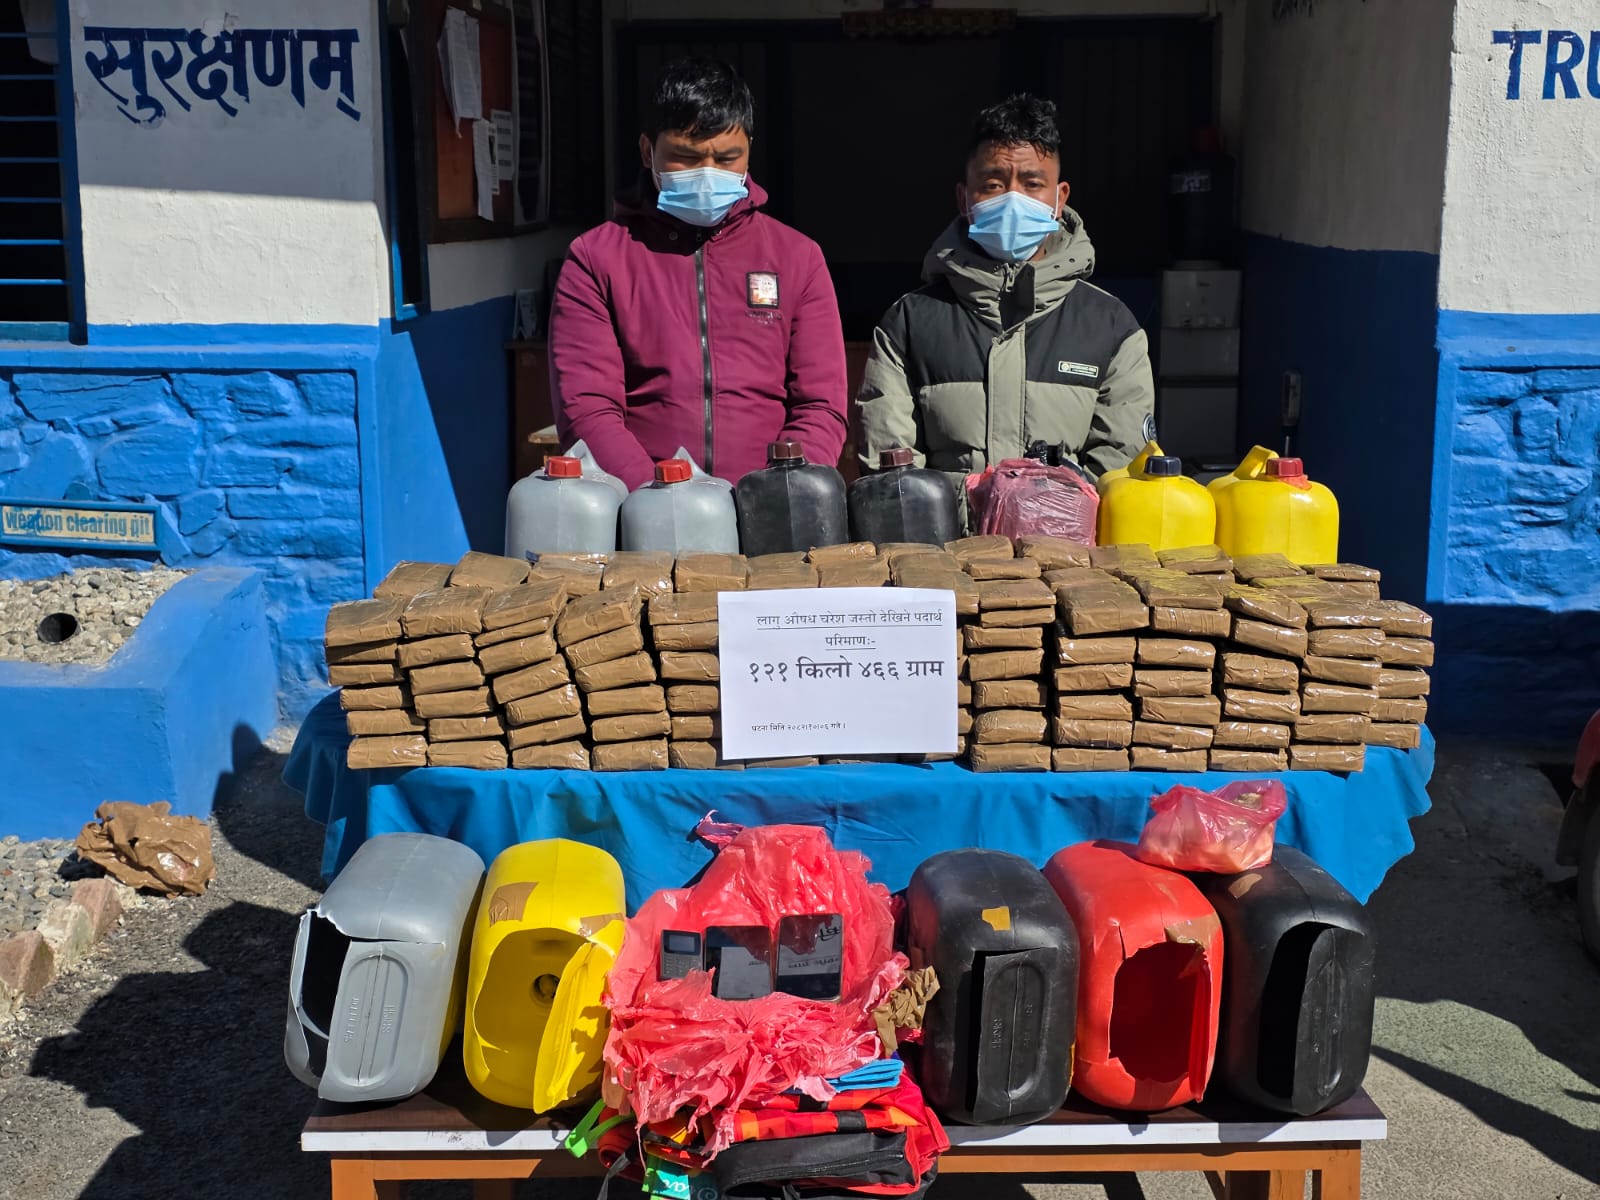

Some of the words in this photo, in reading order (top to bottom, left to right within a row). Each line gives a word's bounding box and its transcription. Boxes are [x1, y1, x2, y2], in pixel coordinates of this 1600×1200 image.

[66, 512, 127, 537] clearing
[848, 609, 877, 623] जस्तो
[879, 608, 911, 622] देखिने
[914, 608, 943, 622] पदार्थ
[749, 662, 788, 682] १२१
[795, 655, 852, 679] किलो
[858, 661, 900, 680] ४६६
[905, 660, 945, 677] ग्राम
